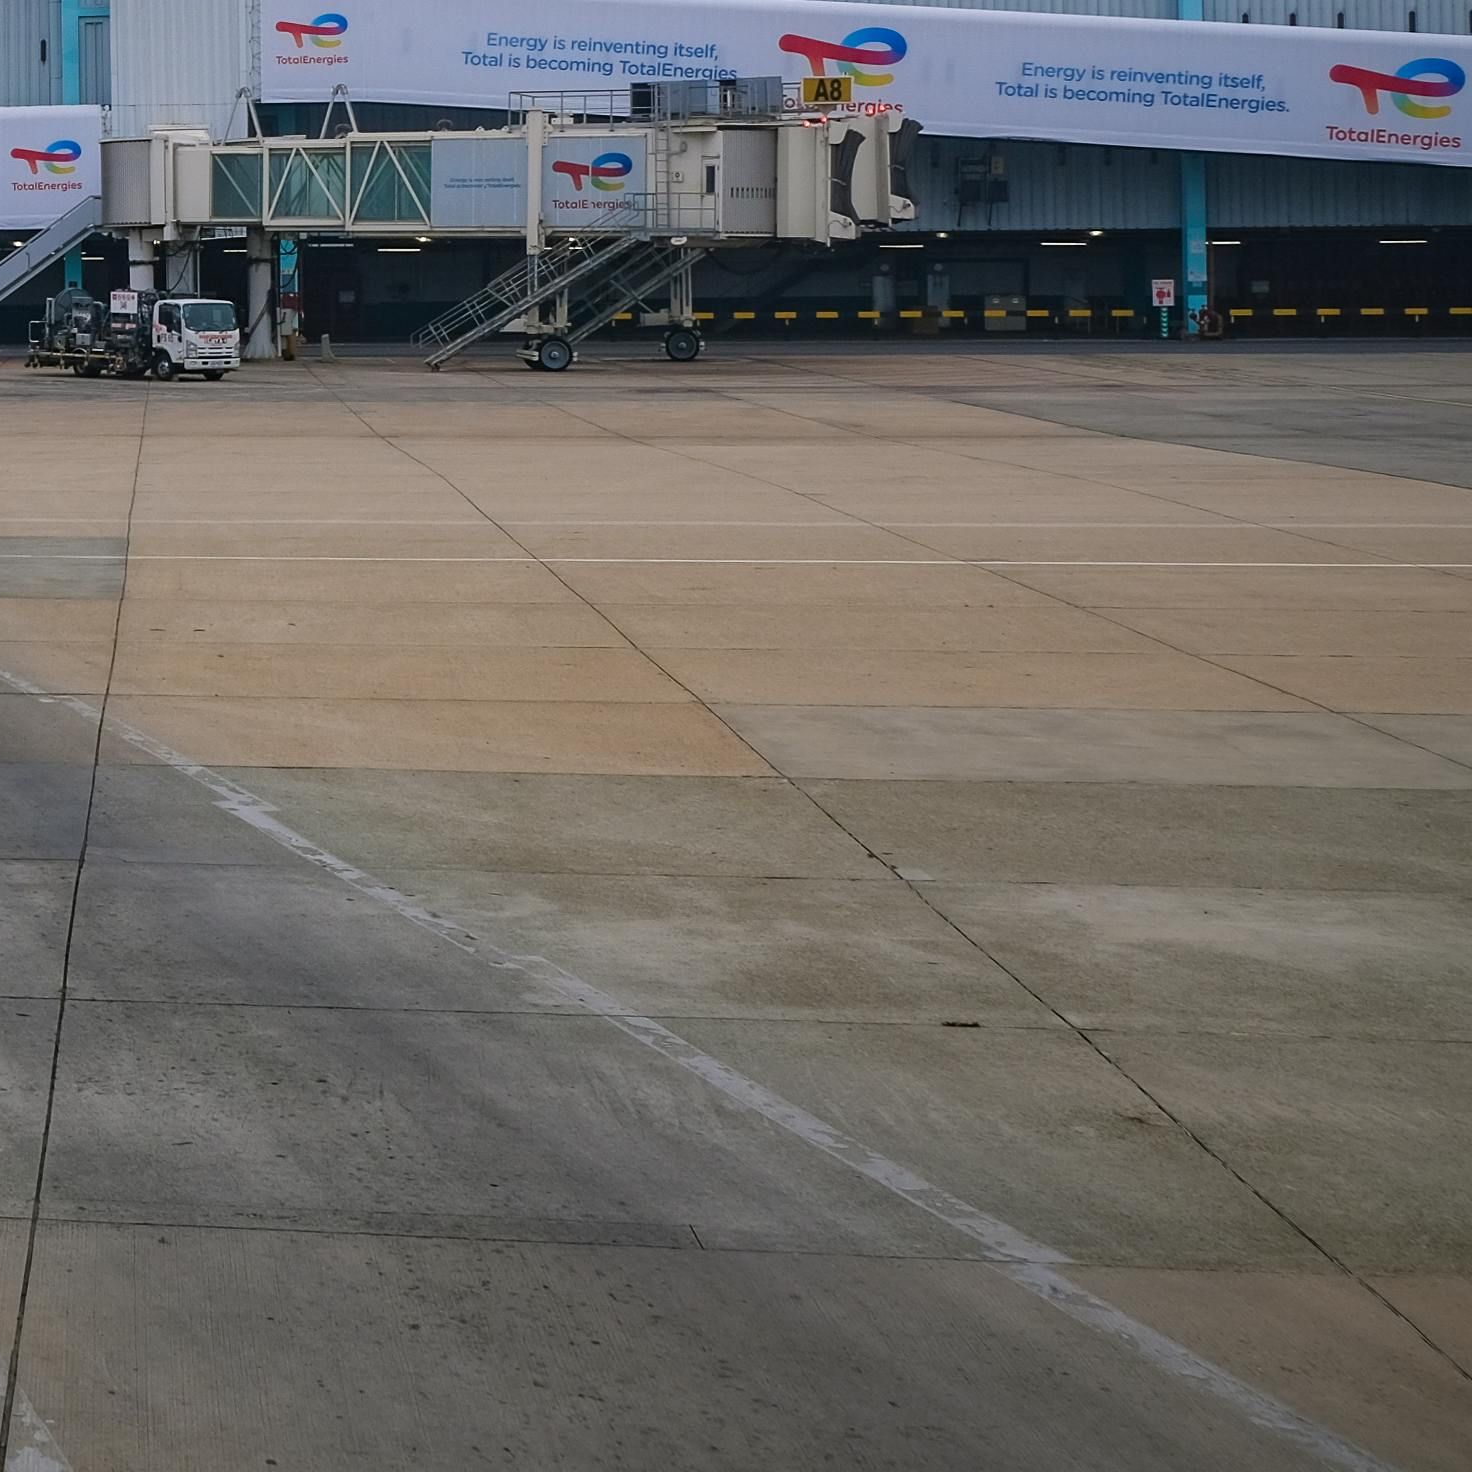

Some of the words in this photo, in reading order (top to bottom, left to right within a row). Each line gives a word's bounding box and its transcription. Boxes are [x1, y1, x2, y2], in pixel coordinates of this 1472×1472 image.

[487, 33, 548, 52] Energy
[553, 36, 565, 50] is
[570, 38, 668, 58] reinventing
[673, 43, 718, 61] itself,
[275, 54, 350, 66] TotalEnergies
[461, 52, 502, 66] Total
[507, 54, 520, 68] is
[525, 55, 613, 76] becoming
[1021, 62, 1086, 82] Energy
[1091, 66, 1104, 80] is
[1109, 68, 1212, 89] reinventing
[1217, 73, 1265, 92] itself,
[814, 78, 842, 101] A8
[995, 82, 1038, 97] Total
[1043, 84, 1057, 98] is
[1062, 85, 1155, 107] becoming
[1159, 91, 1290, 113] TotalEnergies.
[1325, 126, 1462, 150] TotalEnergies
[11, 181, 83, 192] TotalEnergies
